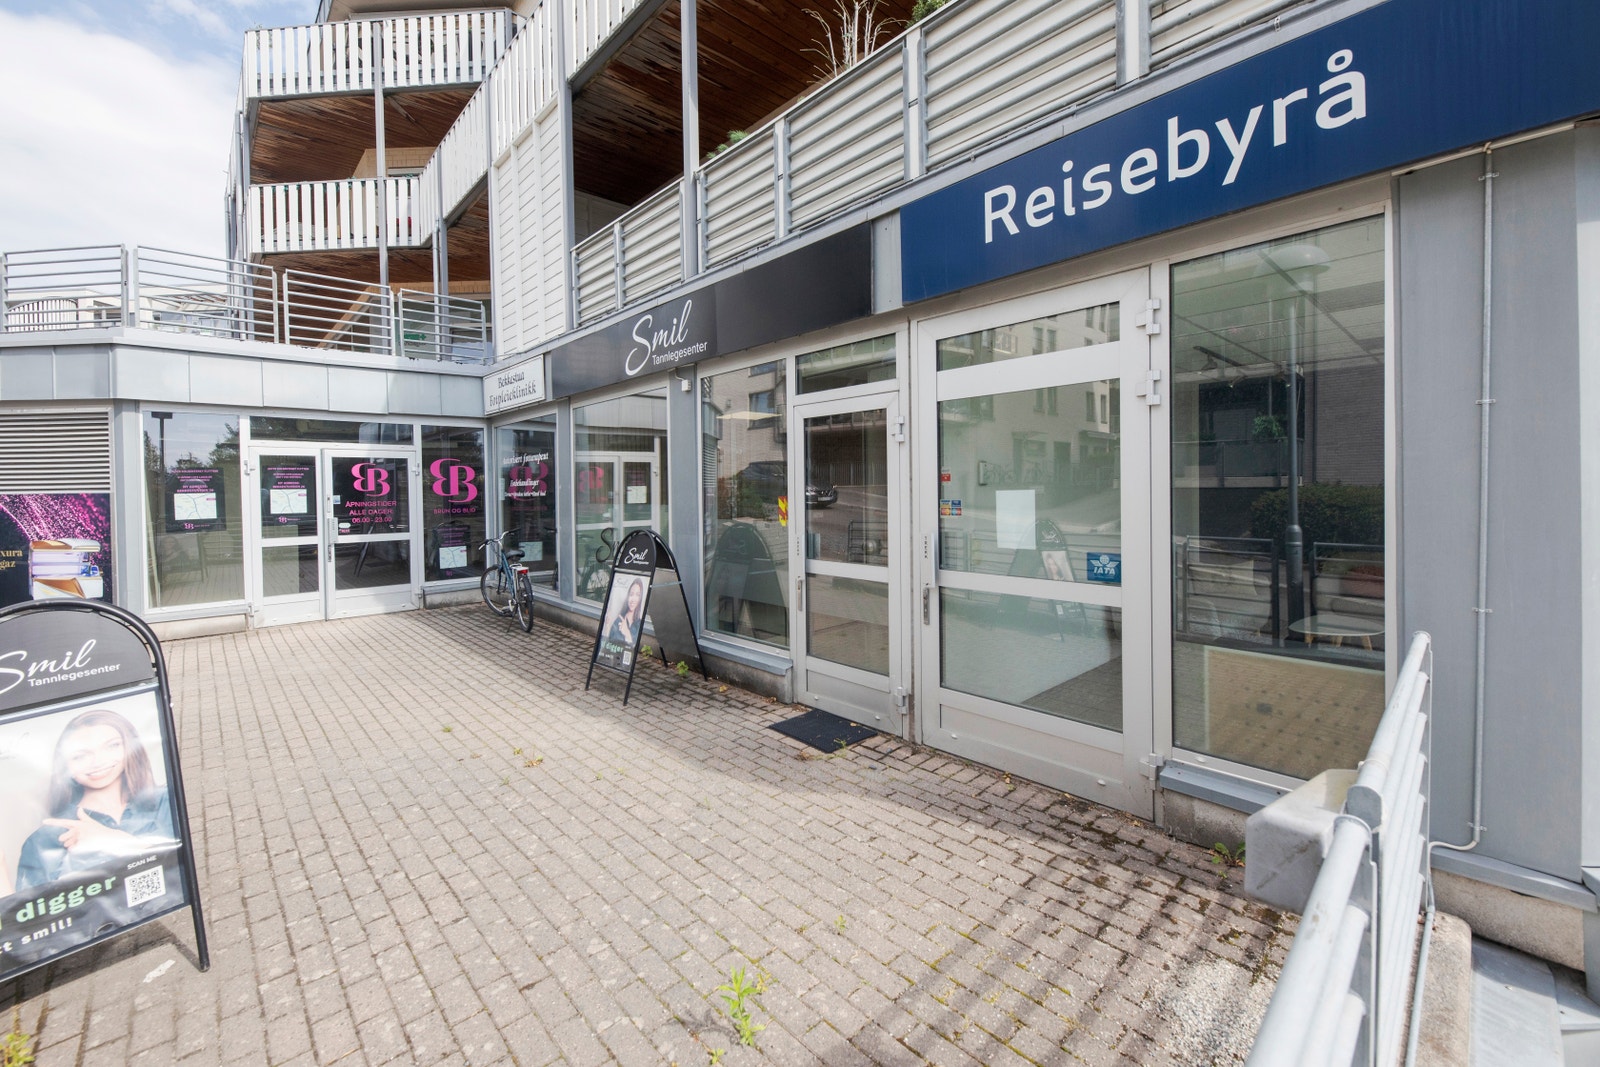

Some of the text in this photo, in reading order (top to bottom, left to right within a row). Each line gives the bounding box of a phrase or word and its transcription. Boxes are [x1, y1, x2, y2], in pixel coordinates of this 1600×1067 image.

[984, 48, 1367, 244] Reisebyrå
[625, 299, 693, 376] Smil
[652, 341, 708, 365] Tannlegesenter
[624, 547, 649, 564] Smil
[1093, 566, 1116, 576] IATA
[27, 663, 121, 687] Tannlegesenter
[127, 854, 157, 870] SCAN ME
[16, 876, 117, 923] digger
[21, 916, 73, 945] smil!
